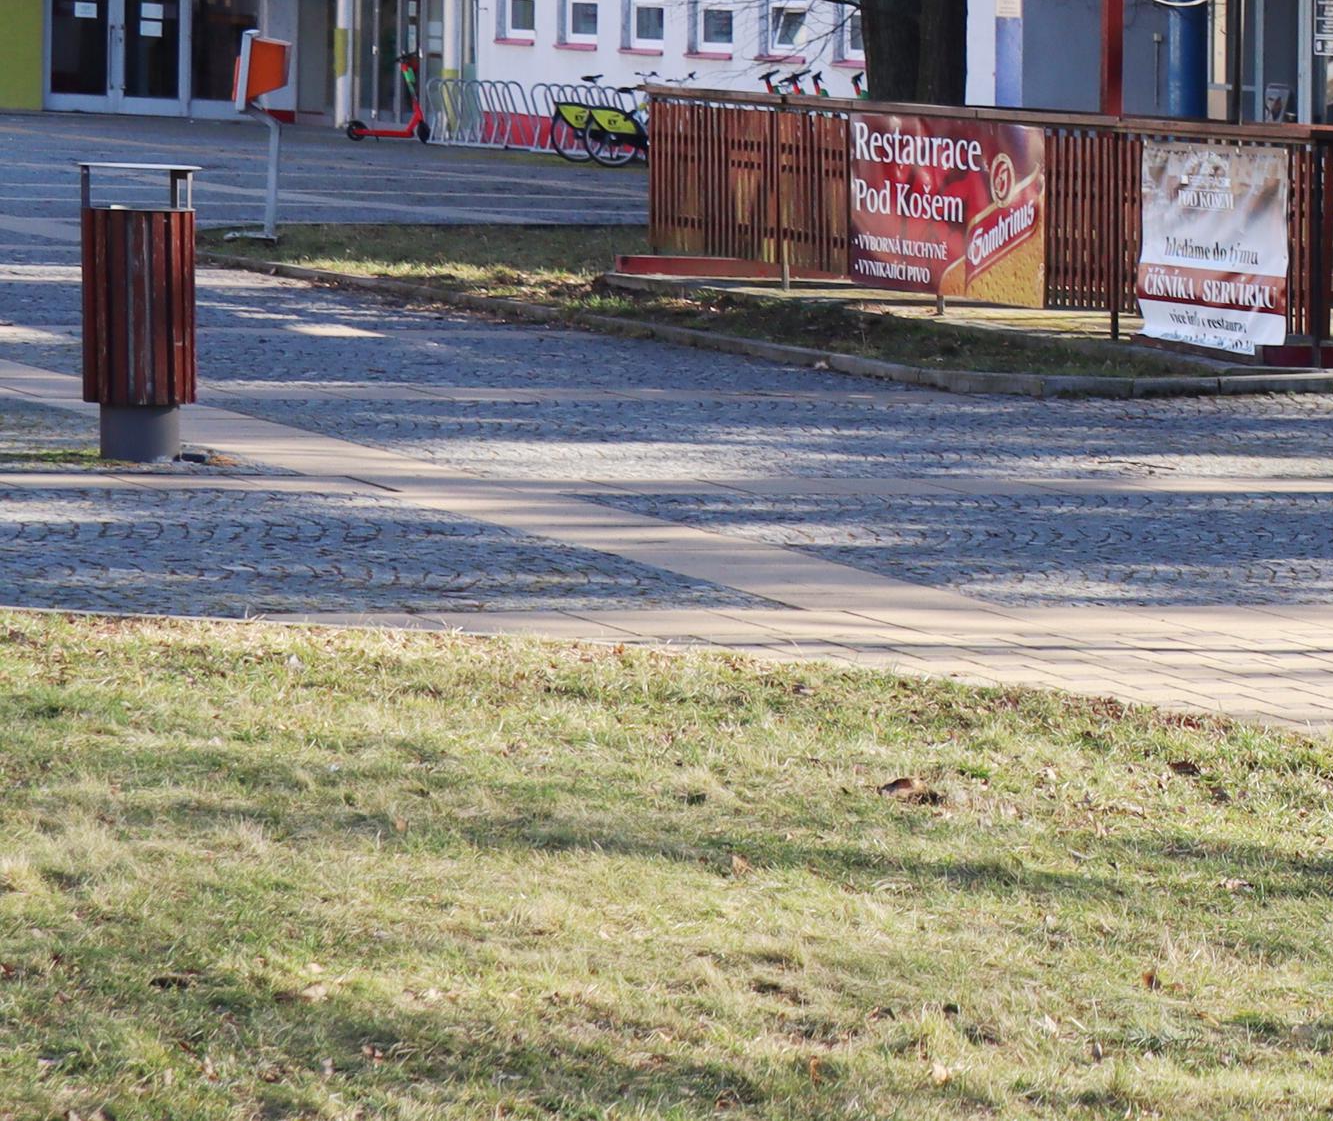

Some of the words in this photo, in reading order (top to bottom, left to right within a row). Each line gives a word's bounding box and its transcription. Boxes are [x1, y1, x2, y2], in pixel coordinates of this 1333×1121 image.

[854, 122, 982, 172] Restaurace
[855, 178, 891, 215] Pod
[896, 183, 964, 223] Košem
[858, 232, 901, 254] VÝBORNÁ
[902, 238, 948, 261] KUCHYNĚ
[968, 199, 1035, 267] Gambrinus
[1165, 236, 1210, 261] hledáme
[1213, 242, 1227, 260] do
[858, 259, 907, 281] VYNIKAJÍCÍ
[907, 266, 931, 284] PIVO
[1144, 267, 1195, 301] ČÍŠNÍKA
